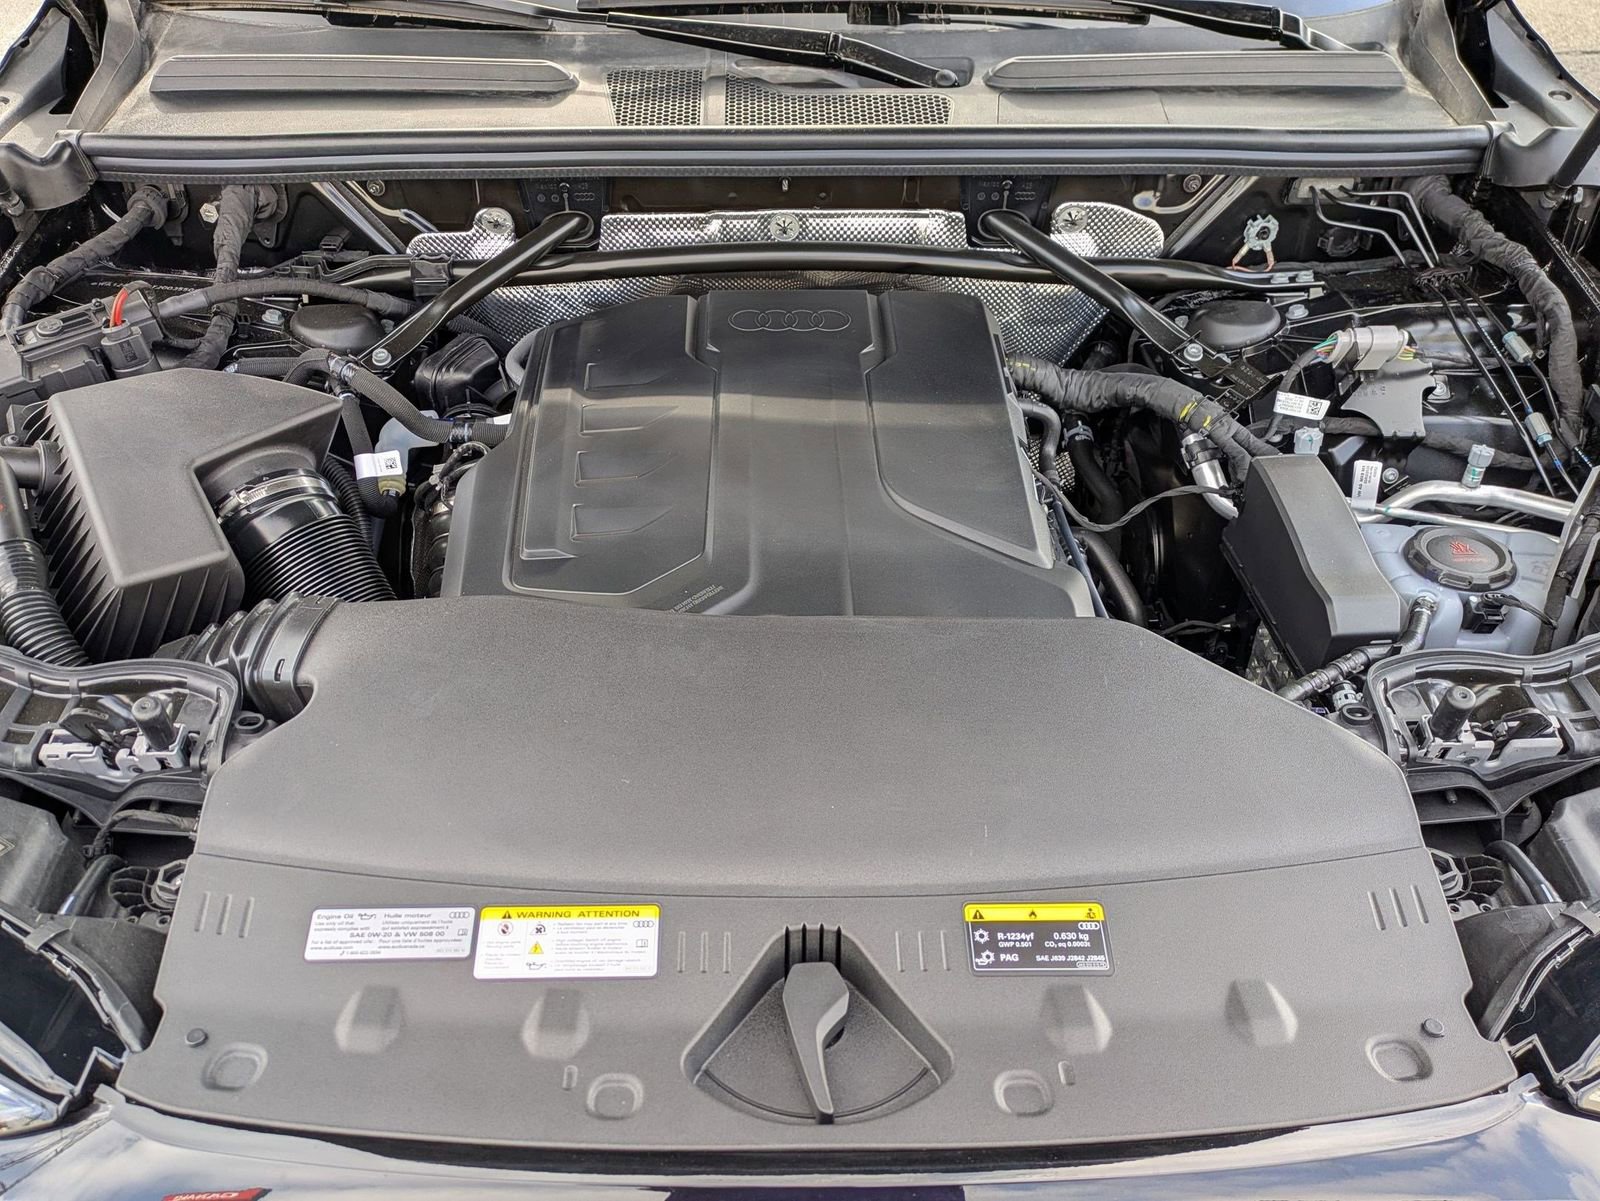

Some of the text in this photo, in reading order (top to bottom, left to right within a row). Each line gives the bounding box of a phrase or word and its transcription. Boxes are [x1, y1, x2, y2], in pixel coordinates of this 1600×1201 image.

[517, 910, 640, 918] WARNING ATTENTION
[997, 932, 1035, 941] R-1234yf
[1053, 932, 1089, 942] 0.630 kg
